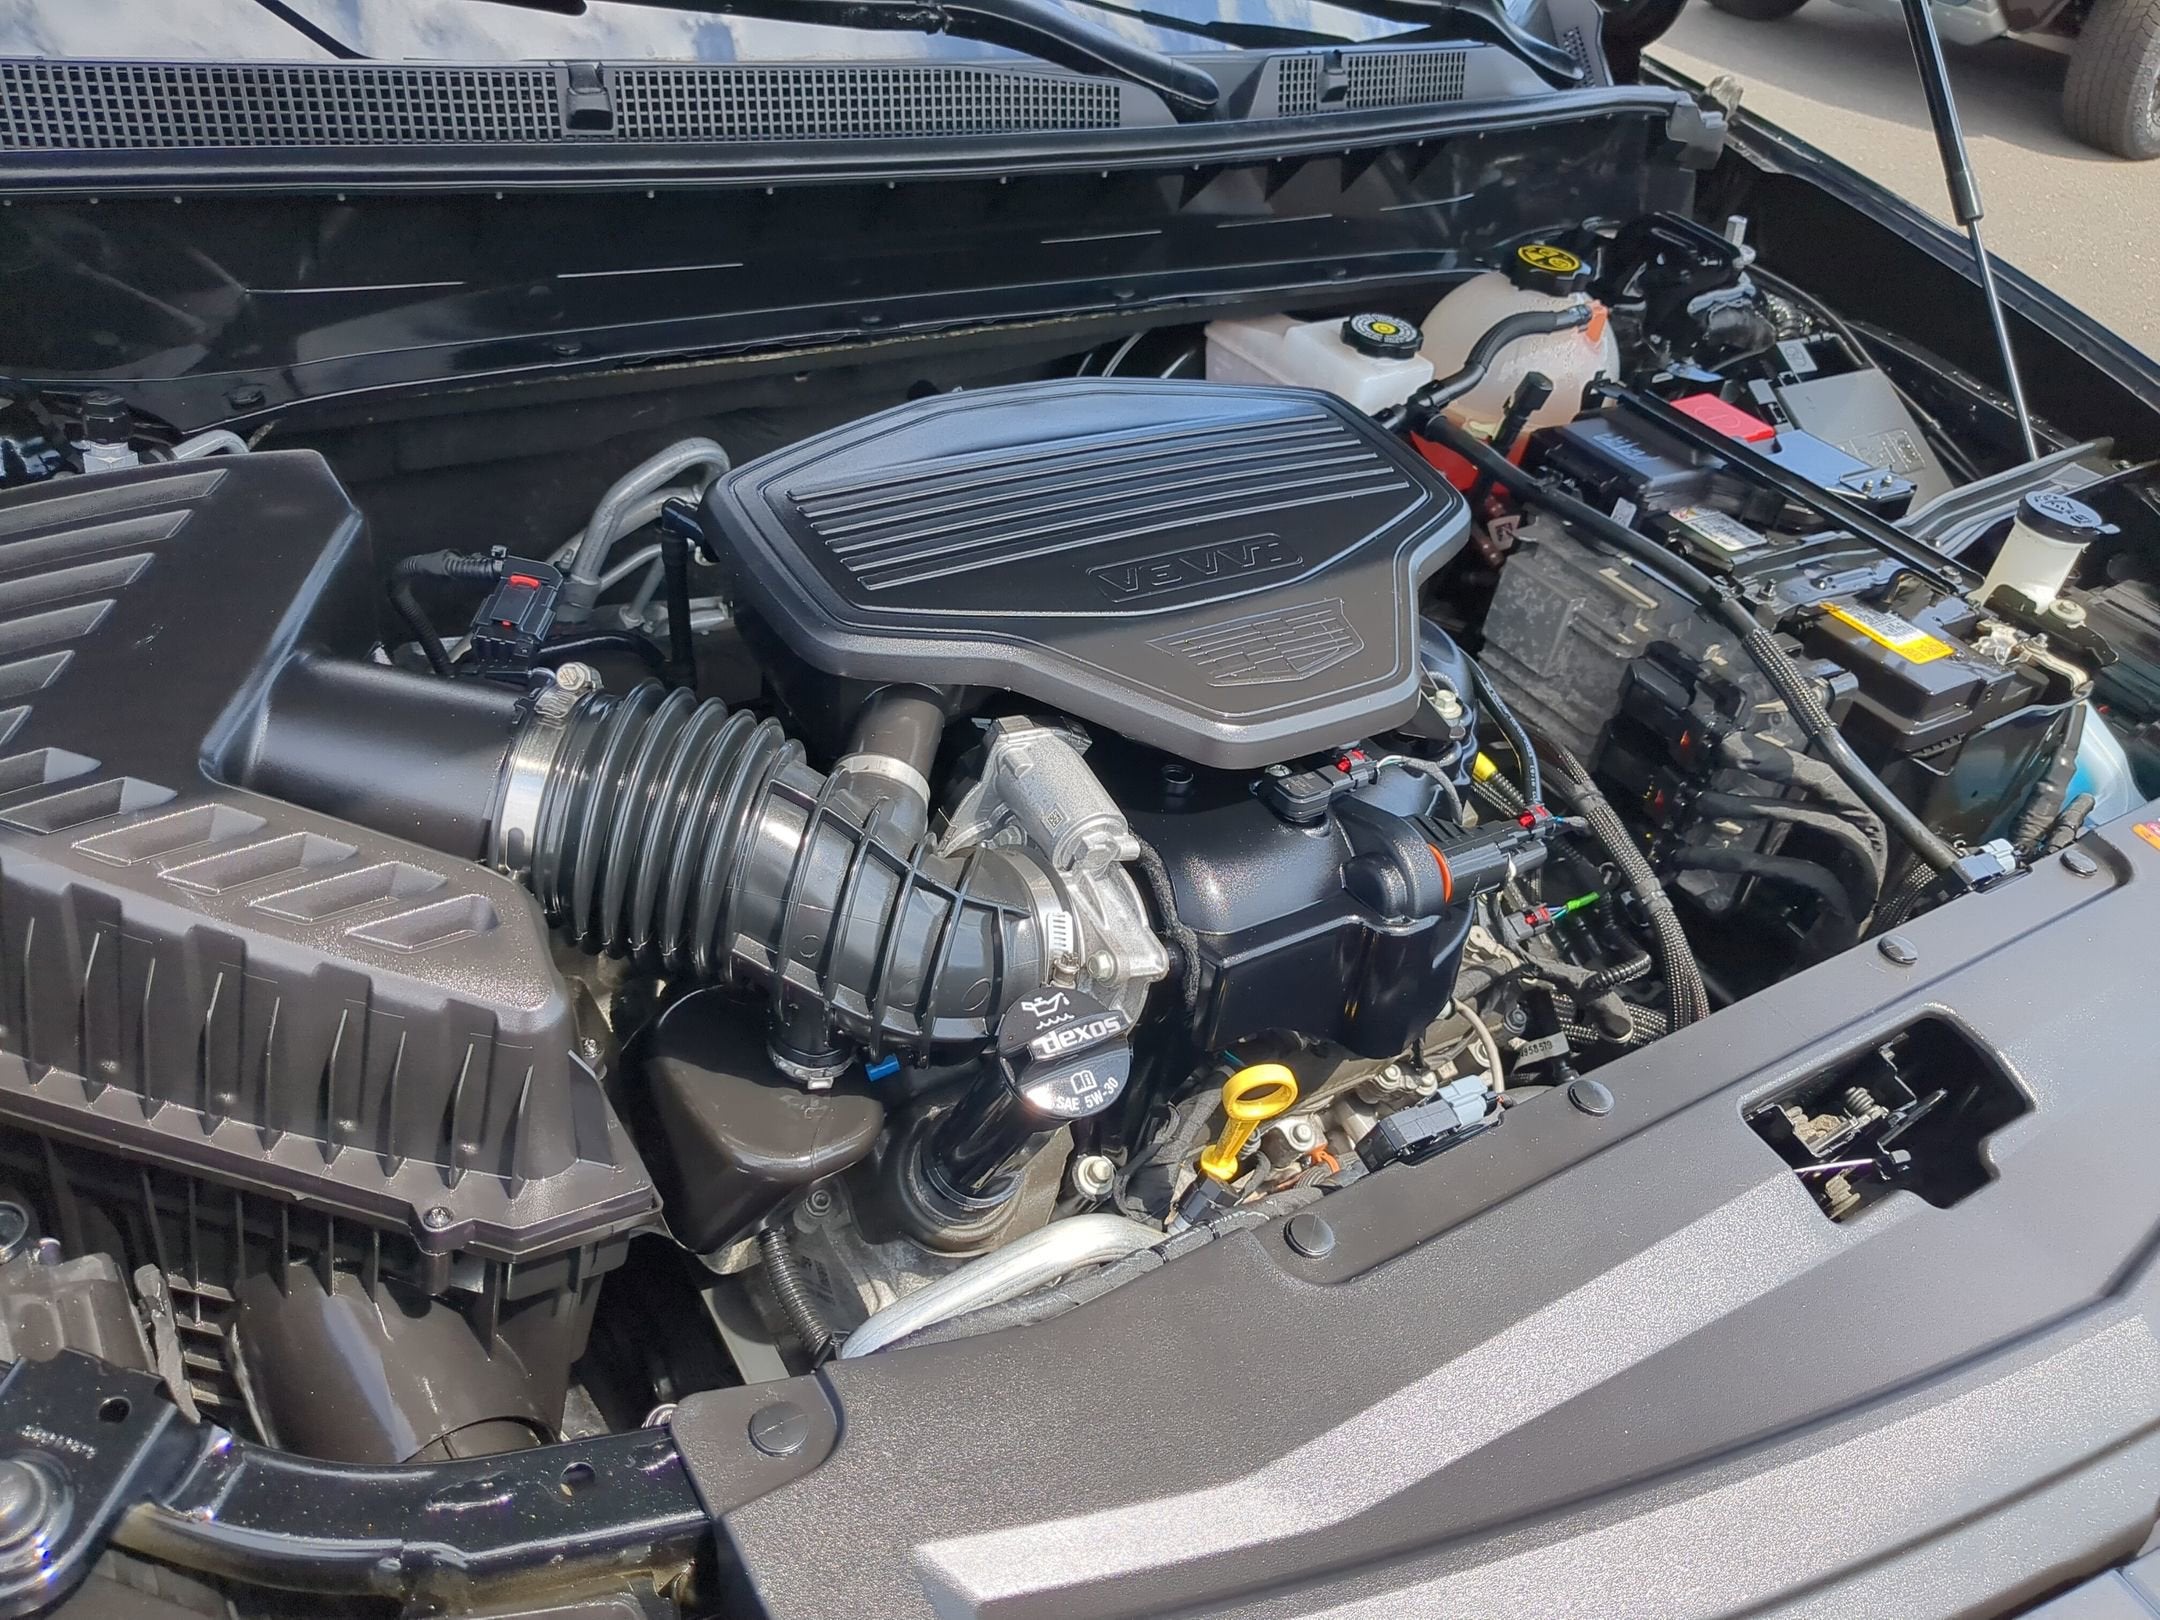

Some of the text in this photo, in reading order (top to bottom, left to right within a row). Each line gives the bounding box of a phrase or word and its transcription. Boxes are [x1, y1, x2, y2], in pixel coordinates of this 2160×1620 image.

[1032, 1015, 1122, 1054] dexos
[1055, 1077, 1119, 1111] SAE 5W-30
